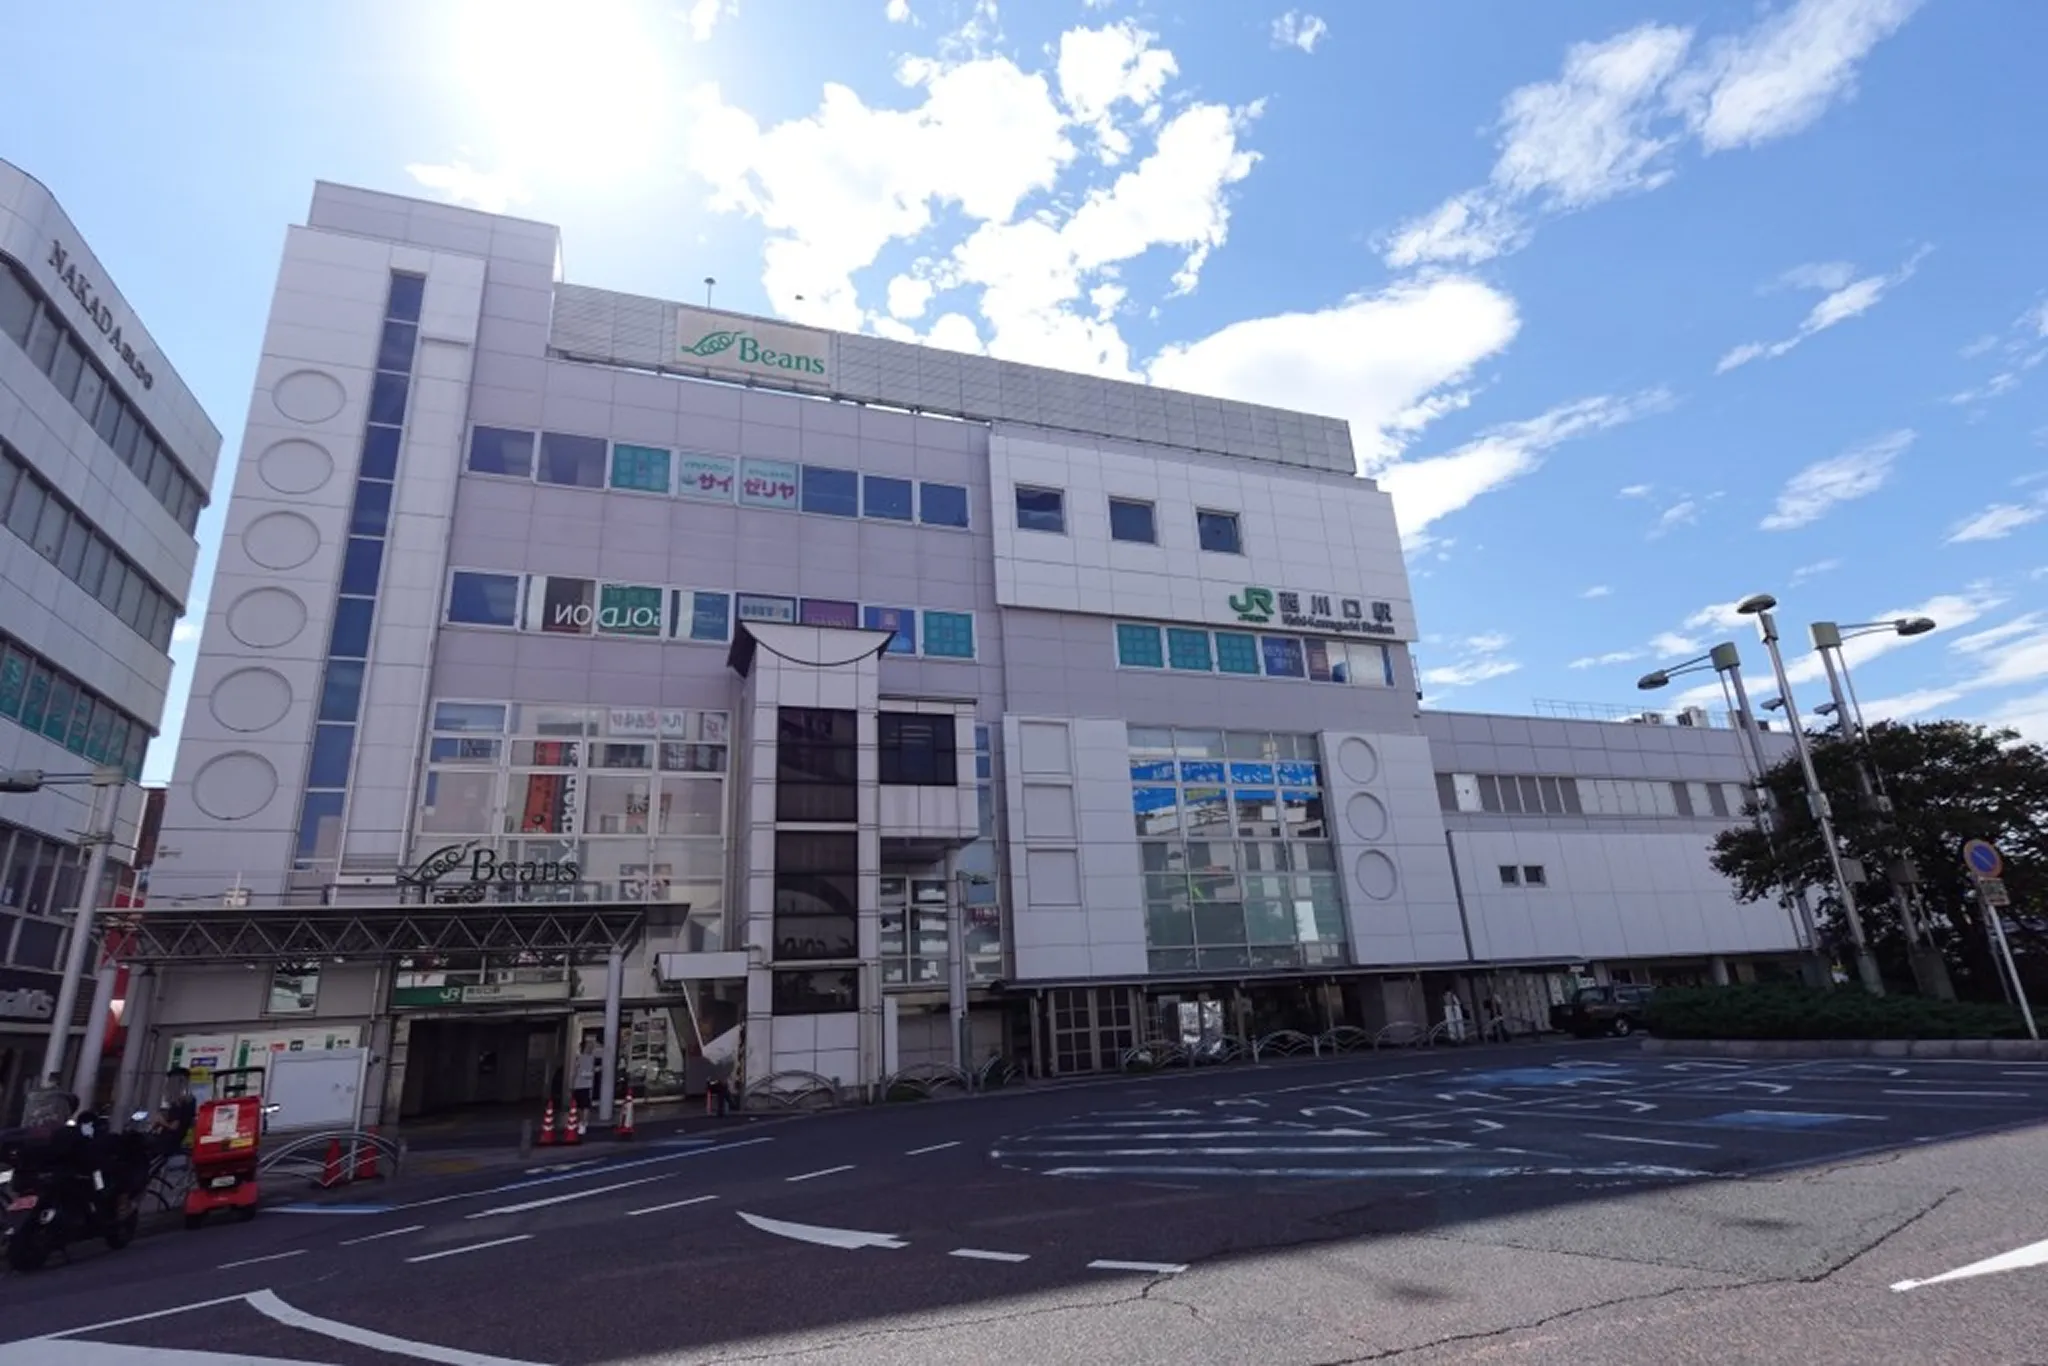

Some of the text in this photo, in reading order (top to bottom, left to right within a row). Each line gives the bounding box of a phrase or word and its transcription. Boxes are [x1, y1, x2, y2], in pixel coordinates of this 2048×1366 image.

[48, 239, 122, 353] NAKADA
[738, 336, 826, 375] Beans
[1229, 586, 1274, 615] JR
[1278, 591, 1393, 622] 西川口駅
[470, 848, 580, 883] Beans
[439, 986, 461, 1000] JR
